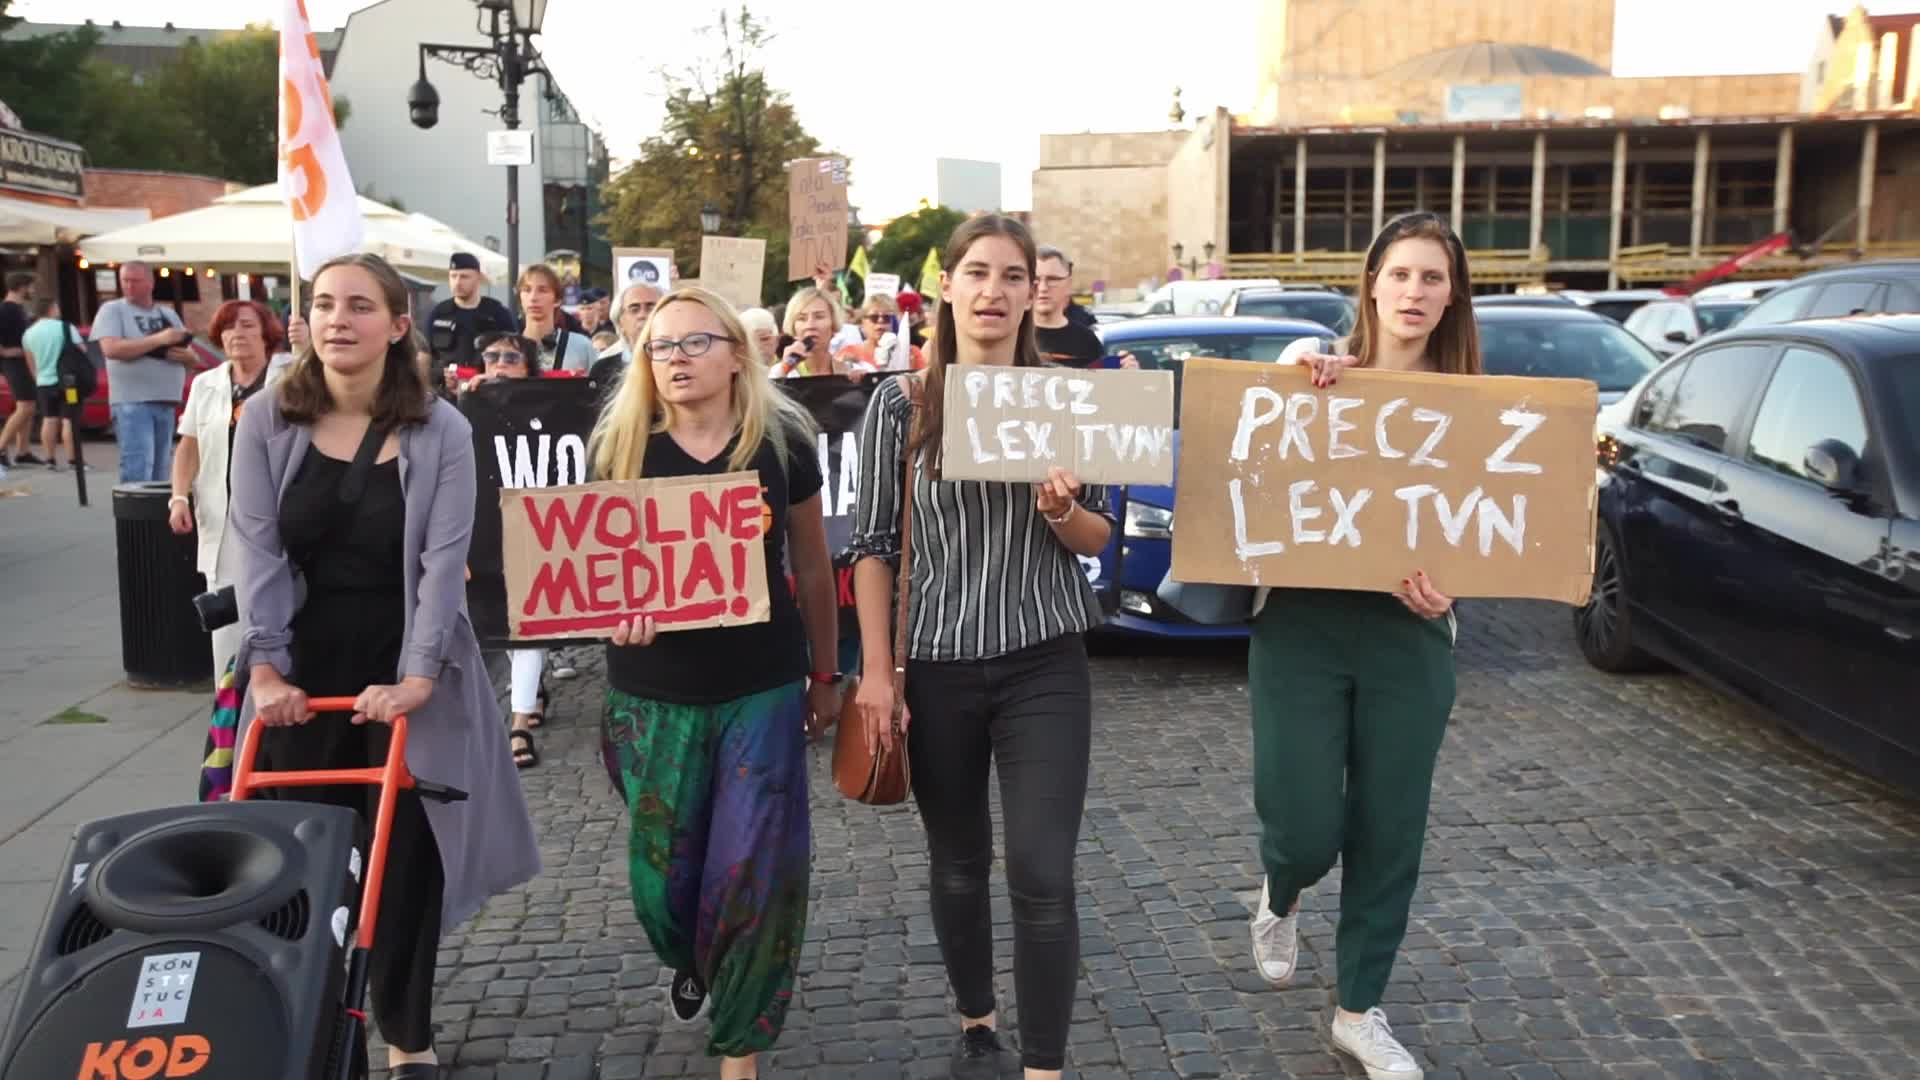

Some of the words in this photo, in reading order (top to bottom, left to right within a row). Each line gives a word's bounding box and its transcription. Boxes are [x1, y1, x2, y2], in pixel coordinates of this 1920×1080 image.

[964, 371, 1099, 415] PRECZ
[966, 417, 1055, 464] LEX
[1075, 423, 1171, 466] TVN
[1229, 386, 1453, 468] PRECZ
[1485, 408, 1547, 475] Z
[522, 485, 763, 552] WOLNE
[1229, 478, 1374, 562] LEX
[1394, 483, 1528, 557] TVN
[522, 541, 750, 618] MEDIA!
[137, 1007, 164, 1020] JA
[76, 1034, 212, 1080] KOD
